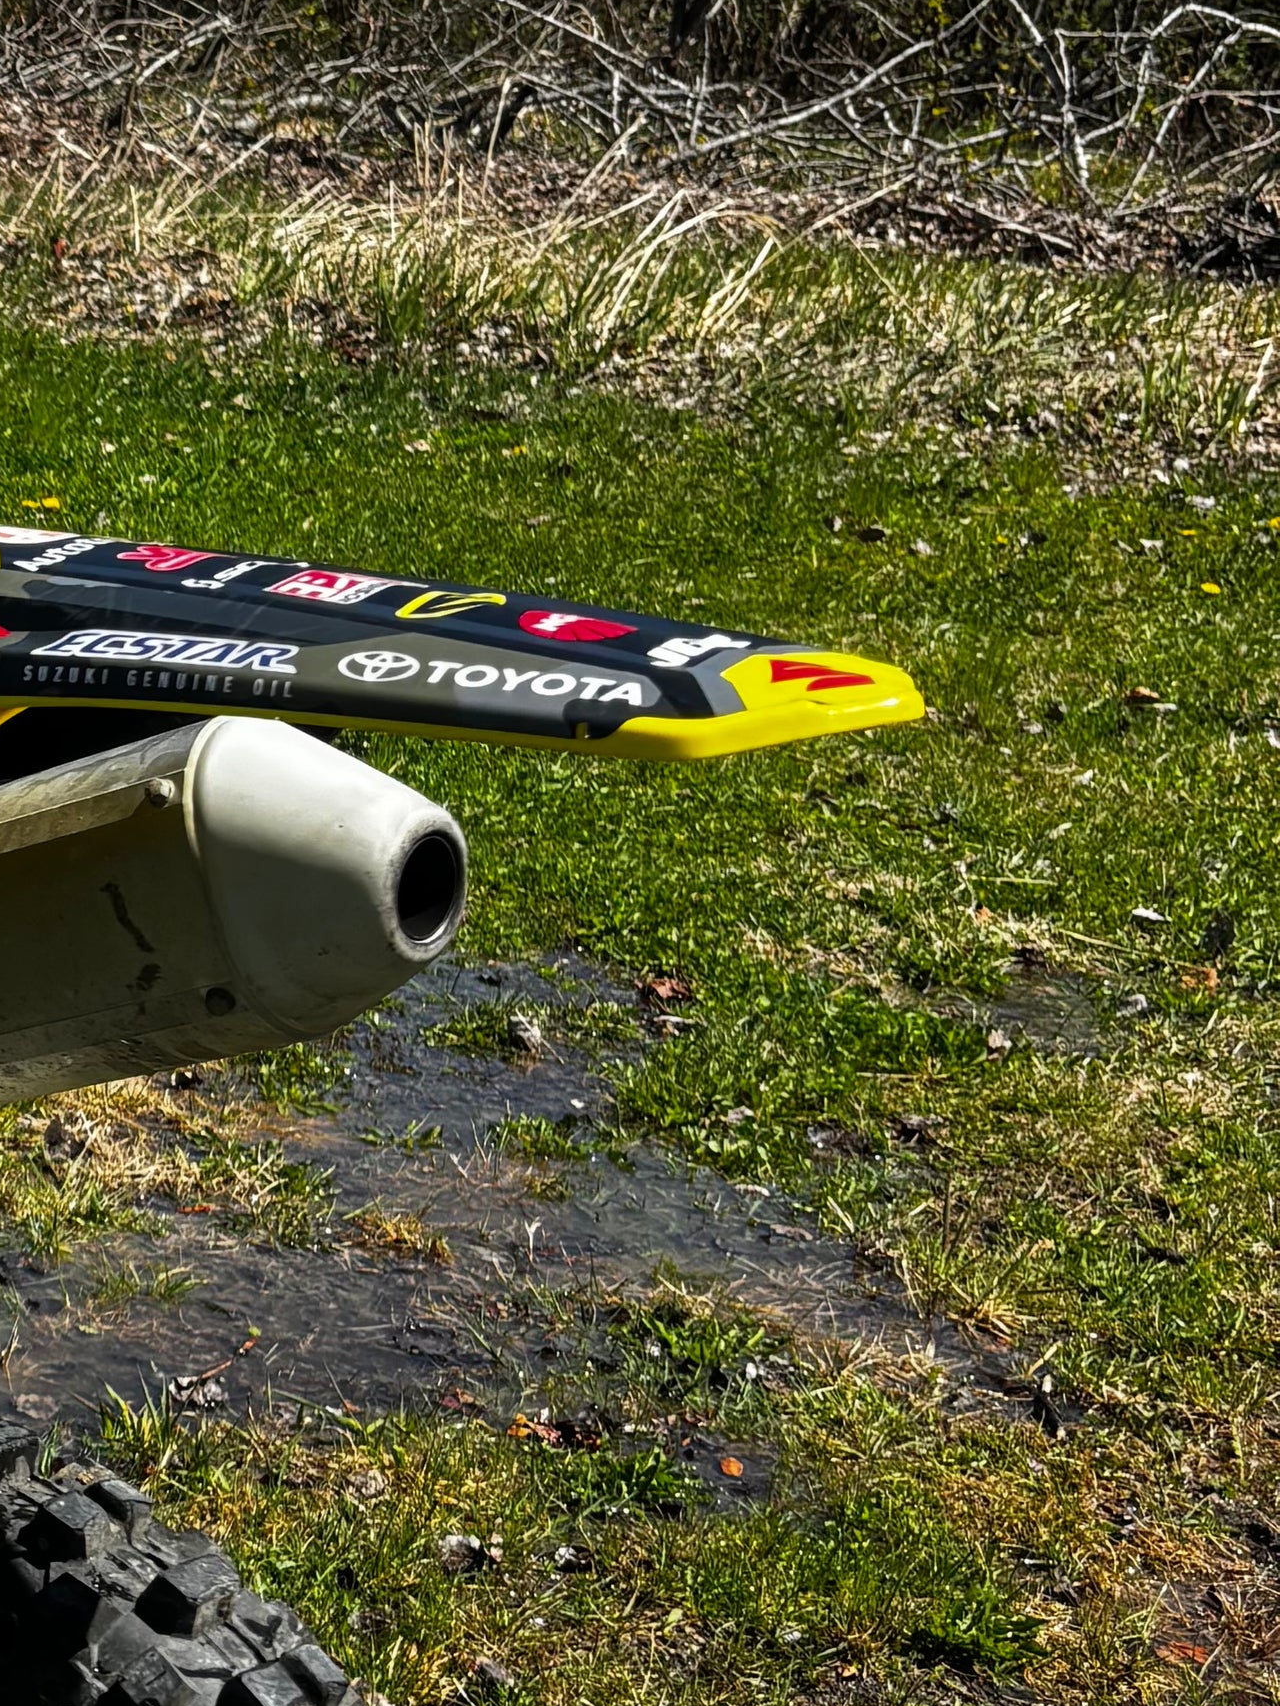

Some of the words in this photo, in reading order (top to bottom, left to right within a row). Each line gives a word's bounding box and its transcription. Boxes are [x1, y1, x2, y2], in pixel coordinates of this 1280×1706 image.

[30, 629, 300, 674] ECSTAR
[23, 664, 109, 685] SUZUKI
[126, 669, 234, 694] GENUINE
[252, 677, 293, 698] OIL
[427, 660, 642, 706] TOYOTA
